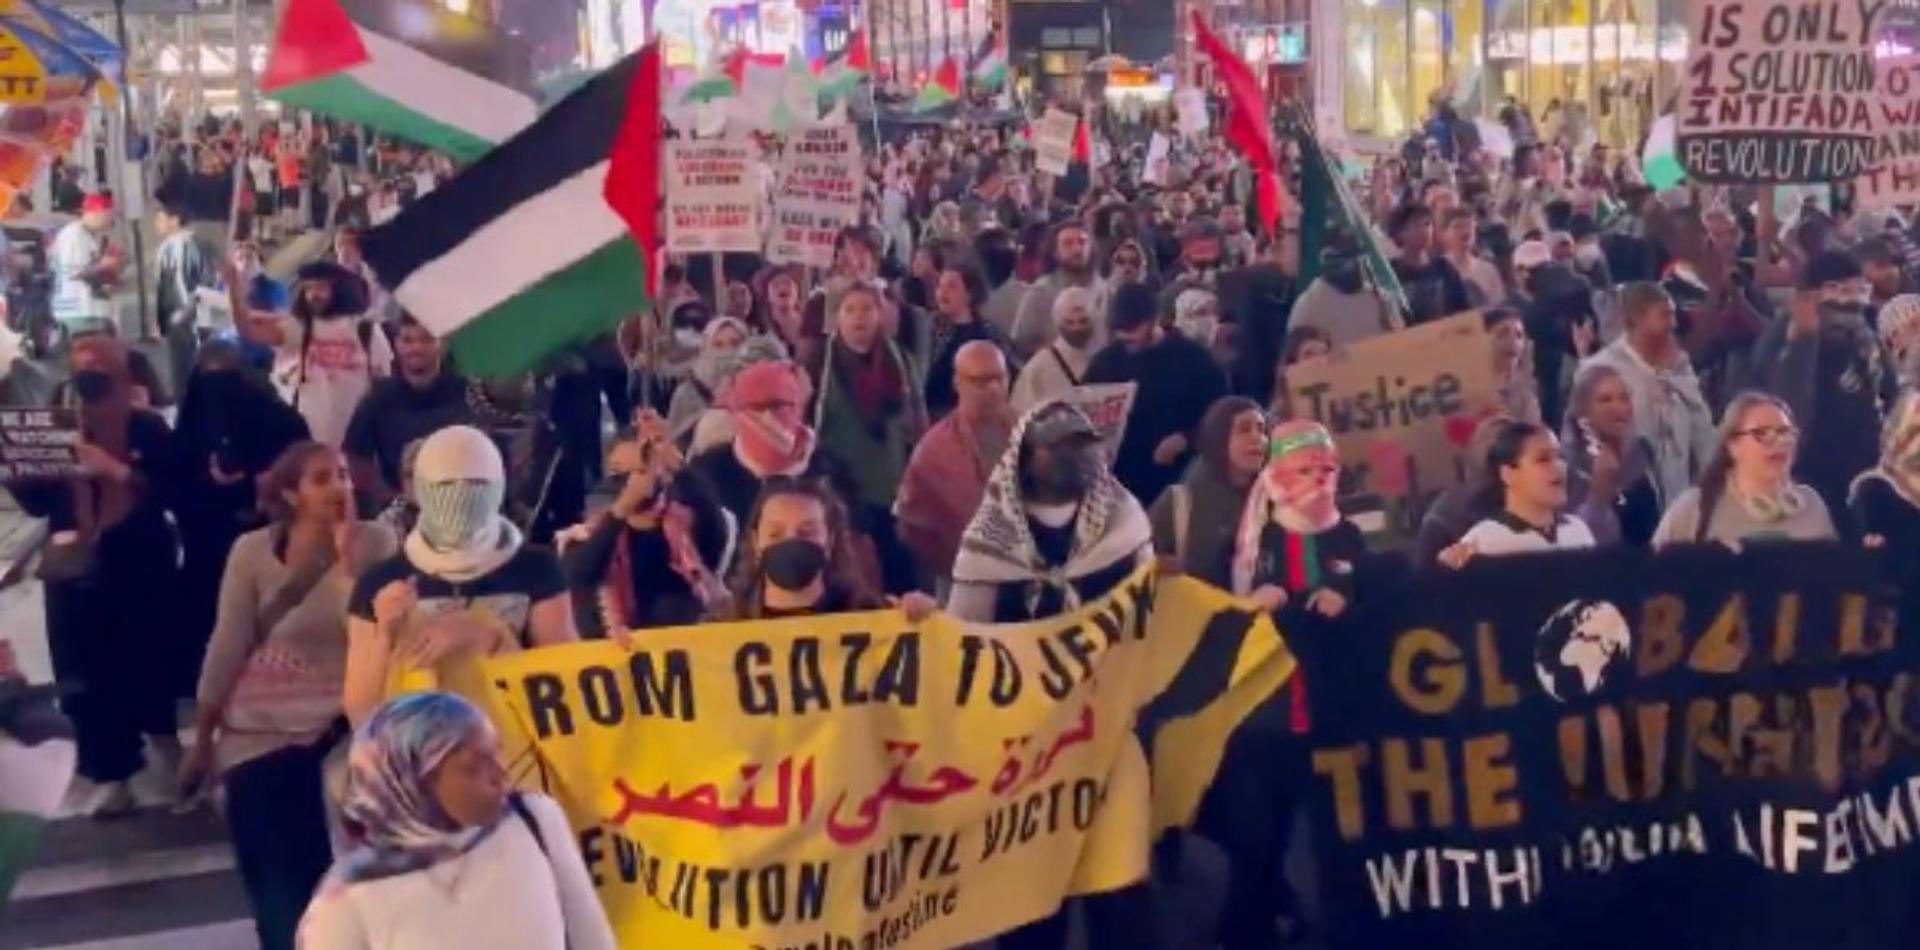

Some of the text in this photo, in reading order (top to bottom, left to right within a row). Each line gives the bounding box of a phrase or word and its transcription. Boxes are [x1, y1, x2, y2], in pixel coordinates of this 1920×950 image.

[1701, 4, 1743, 48] IS
[1761, 0, 1884, 45] ONLY
[1688, 52, 1875, 97] 1 SOLUTION
[1684, 95, 1872, 131] INTIFADA
[1686, 137, 1872, 180] REVOLUTION
[1300, 373, 1462, 434] Justice
[497, 649, 696, 739] ROM
[734, 631, 920, 716] GAZA
[954, 635, 1022, 708] TO
[609, 752, 815, 828] النصر
[826, 737, 978, 847] حتى
[1312, 732, 1522, 842] THE
